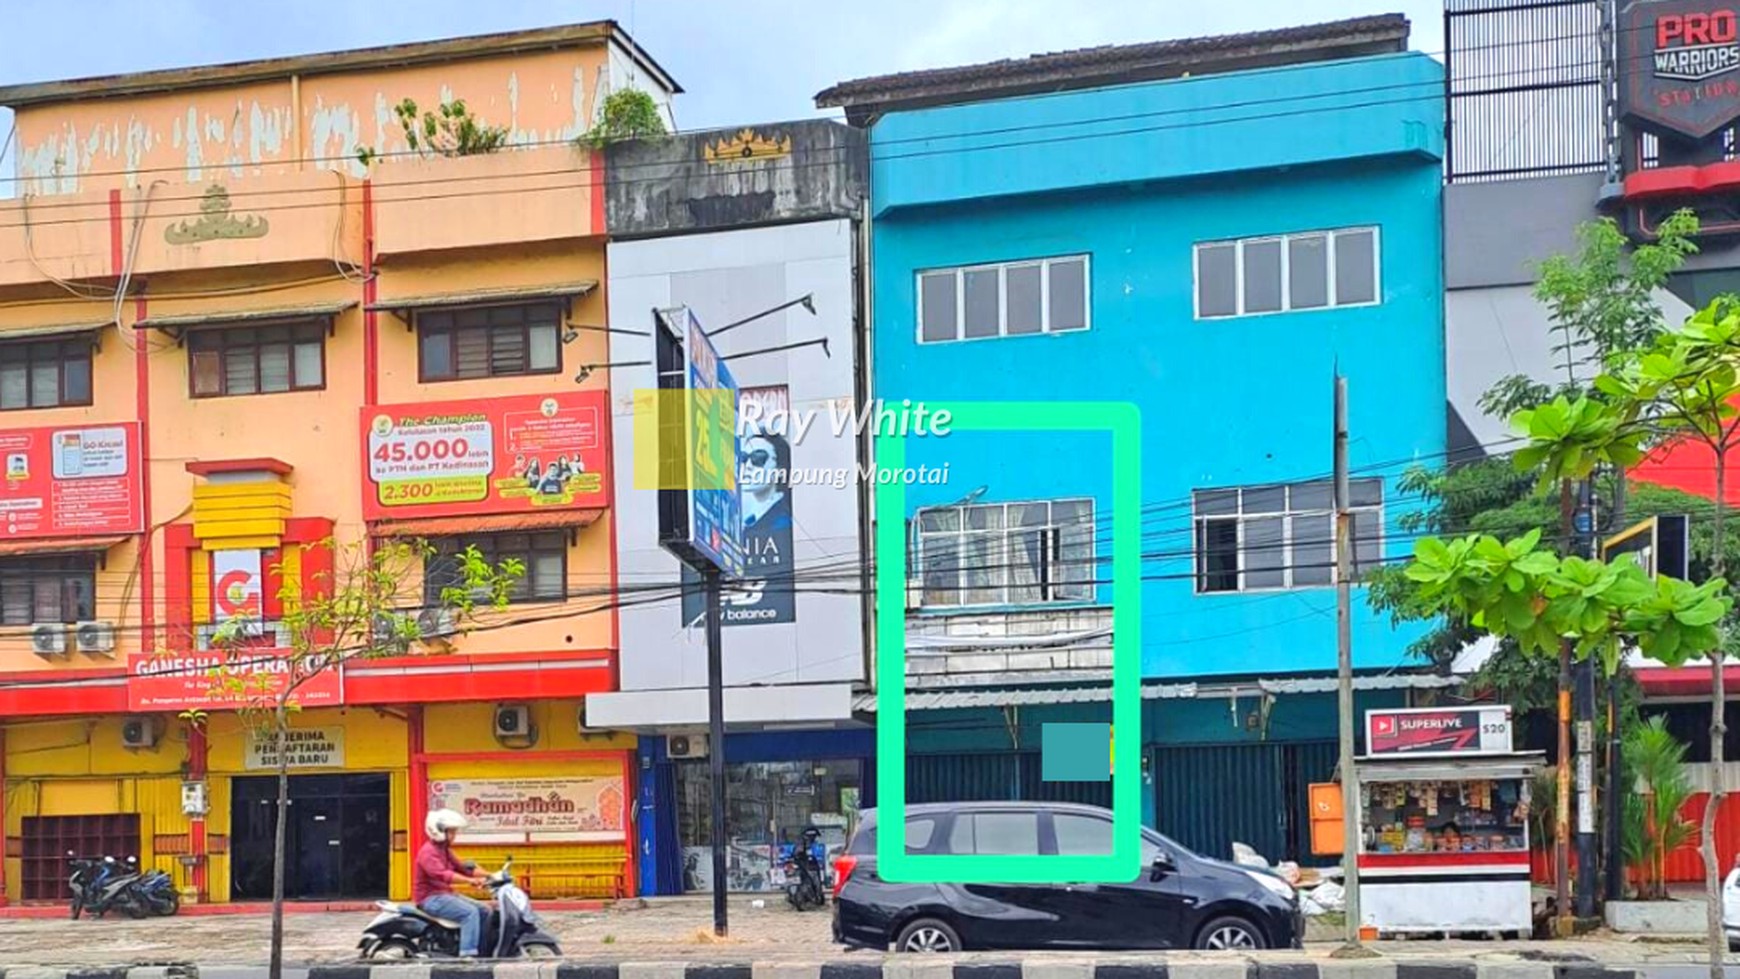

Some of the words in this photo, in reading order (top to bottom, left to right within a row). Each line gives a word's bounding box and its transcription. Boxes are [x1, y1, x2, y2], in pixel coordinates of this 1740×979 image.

[1656, 9, 1736, 49] PRO
[1655, 46, 1739, 74] WARRIORS
[400, 416, 420, 427] The
[424, 413, 487, 426] Champion
[373, 436, 468, 463] 45.000
[388, 464, 407, 473] PTN
[428, 462, 440, 470] PT
[727, 609, 777, 620] balance
[136, 656, 220, 678] GANESHA
[1401, 717, 1463, 730] SUPERLIVE
[255, 742, 335, 754] PENAFTARAN
[261, 755, 296, 765] SISA
[299, 754, 329, 764] BARU
[464, 795, 575, 816] Ramadhan
